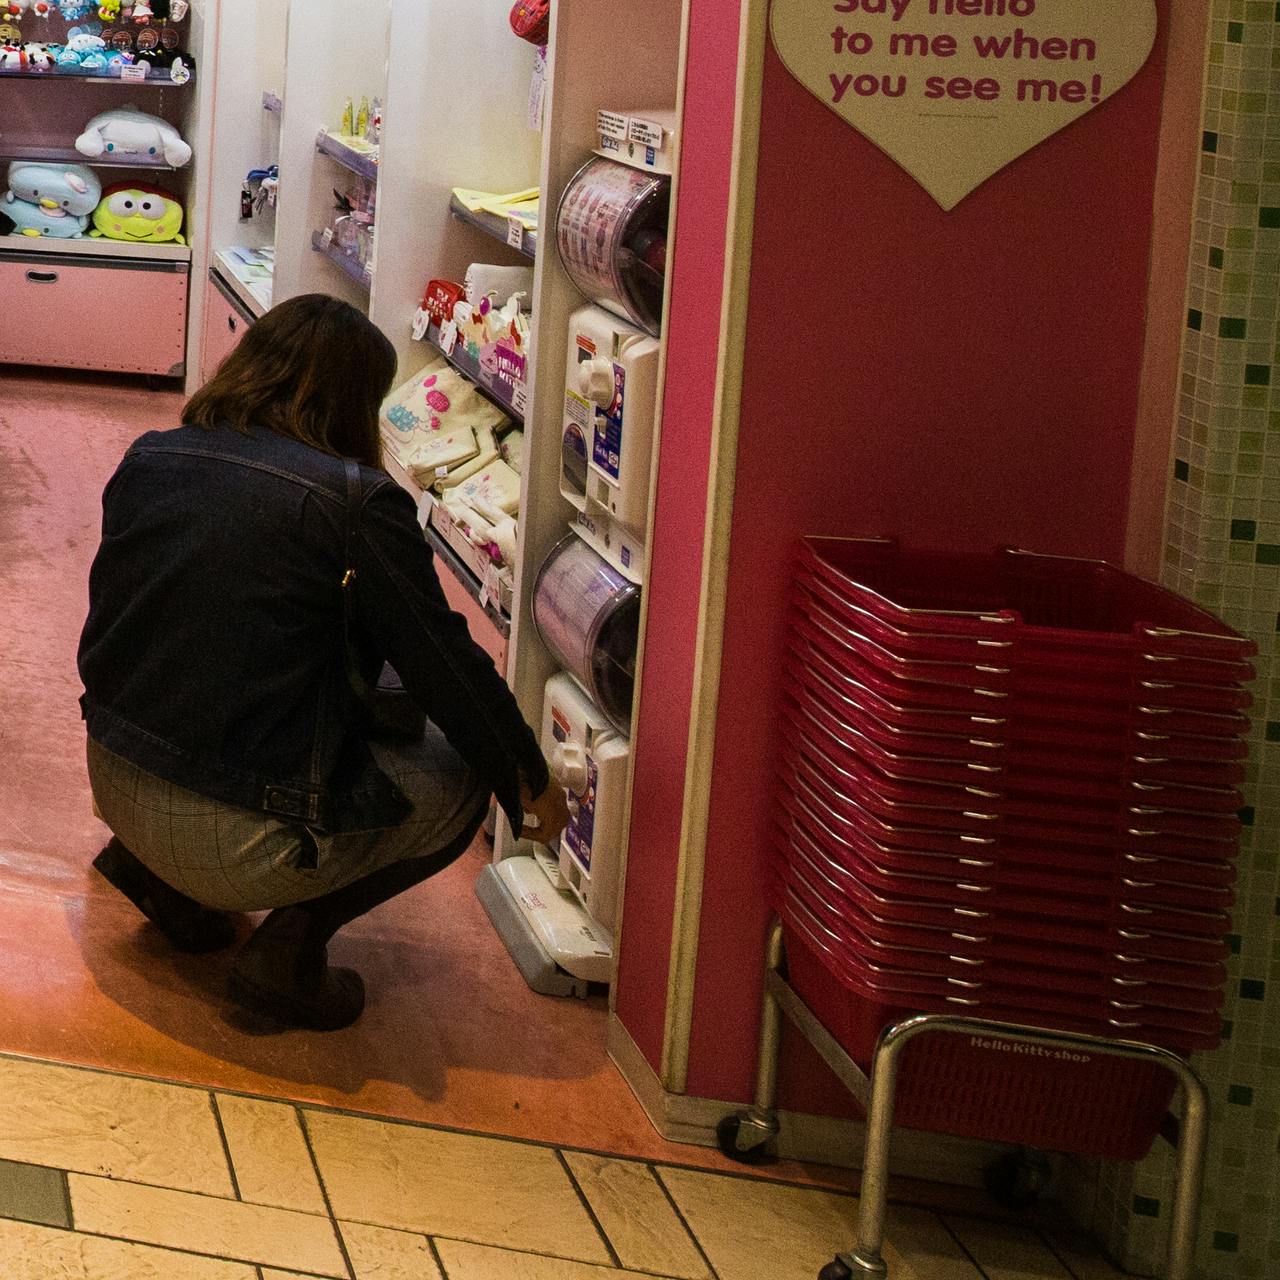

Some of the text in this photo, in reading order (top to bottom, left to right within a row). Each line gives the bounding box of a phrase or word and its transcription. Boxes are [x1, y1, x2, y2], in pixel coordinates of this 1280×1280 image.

[831, 26, 1096, 61] to me when
[829, 73, 1101, 103] you see me!
